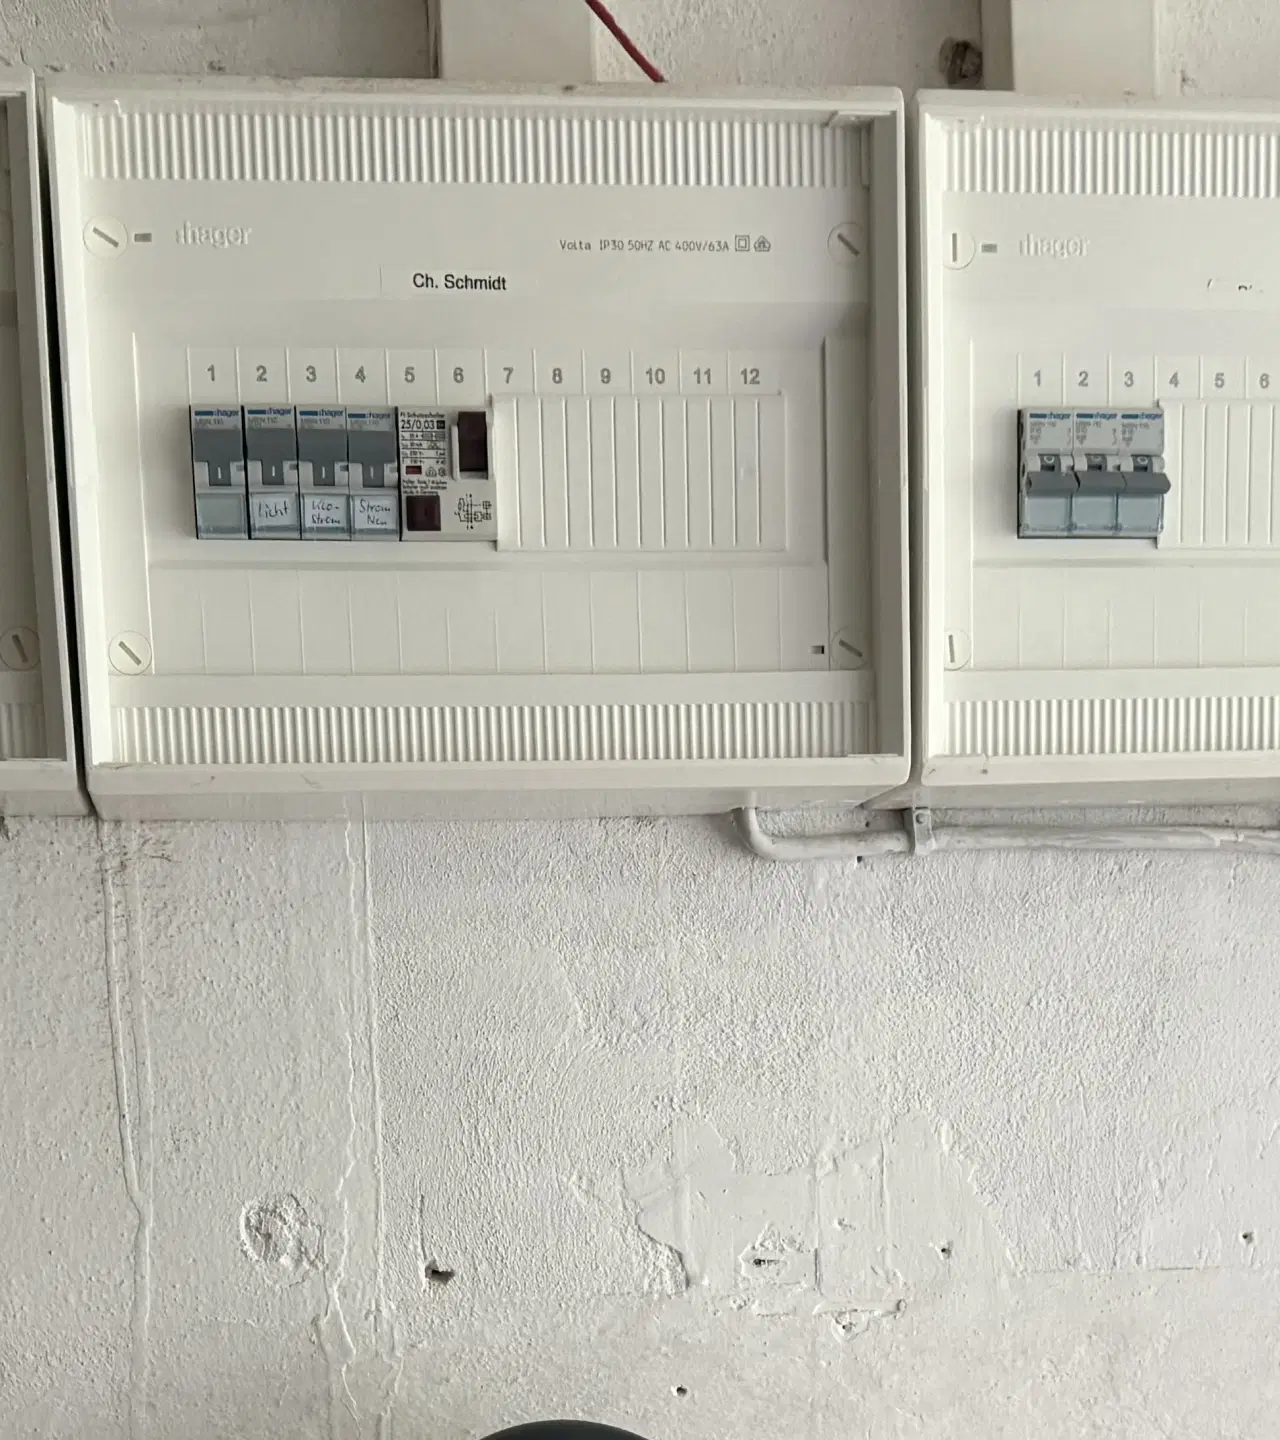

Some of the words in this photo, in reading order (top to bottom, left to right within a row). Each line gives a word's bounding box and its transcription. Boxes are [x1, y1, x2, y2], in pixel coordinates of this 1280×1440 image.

[559, 239, 592, 250] Volta
[599, 239, 624, 251] IP30
[627, 239, 654, 251] 50HZ
[658, 239, 671, 251] AC
[674, 240, 730, 252] 400V/63A
[413, 272, 438, 289] Ch.
[444, 273, 506, 290] Schmidt
[207, 364, 215, 381] 1
[256, 365, 267, 382] 2
[306, 365, 317, 382] 3
[355, 366, 366, 383] 4
[404, 366, 415, 383] 5
[453, 367, 464, 383] 6
[503, 367, 514, 384] 7
[552, 367, 563, 384] 8
[600, 368, 611, 384] 9
[645, 368, 666, 385] 10
[693, 368, 712, 385] 11
[740, 368, 761, 385] 12
[1034, 370, 1041, 386] 1
[1078, 371, 1089, 387] 2
[1124, 371, 1134, 387] 3
[1169, 372, 1180, 388] 4
[1214, 373, 1225, 389] 5
[1259, 373, 1270, 389] 6
